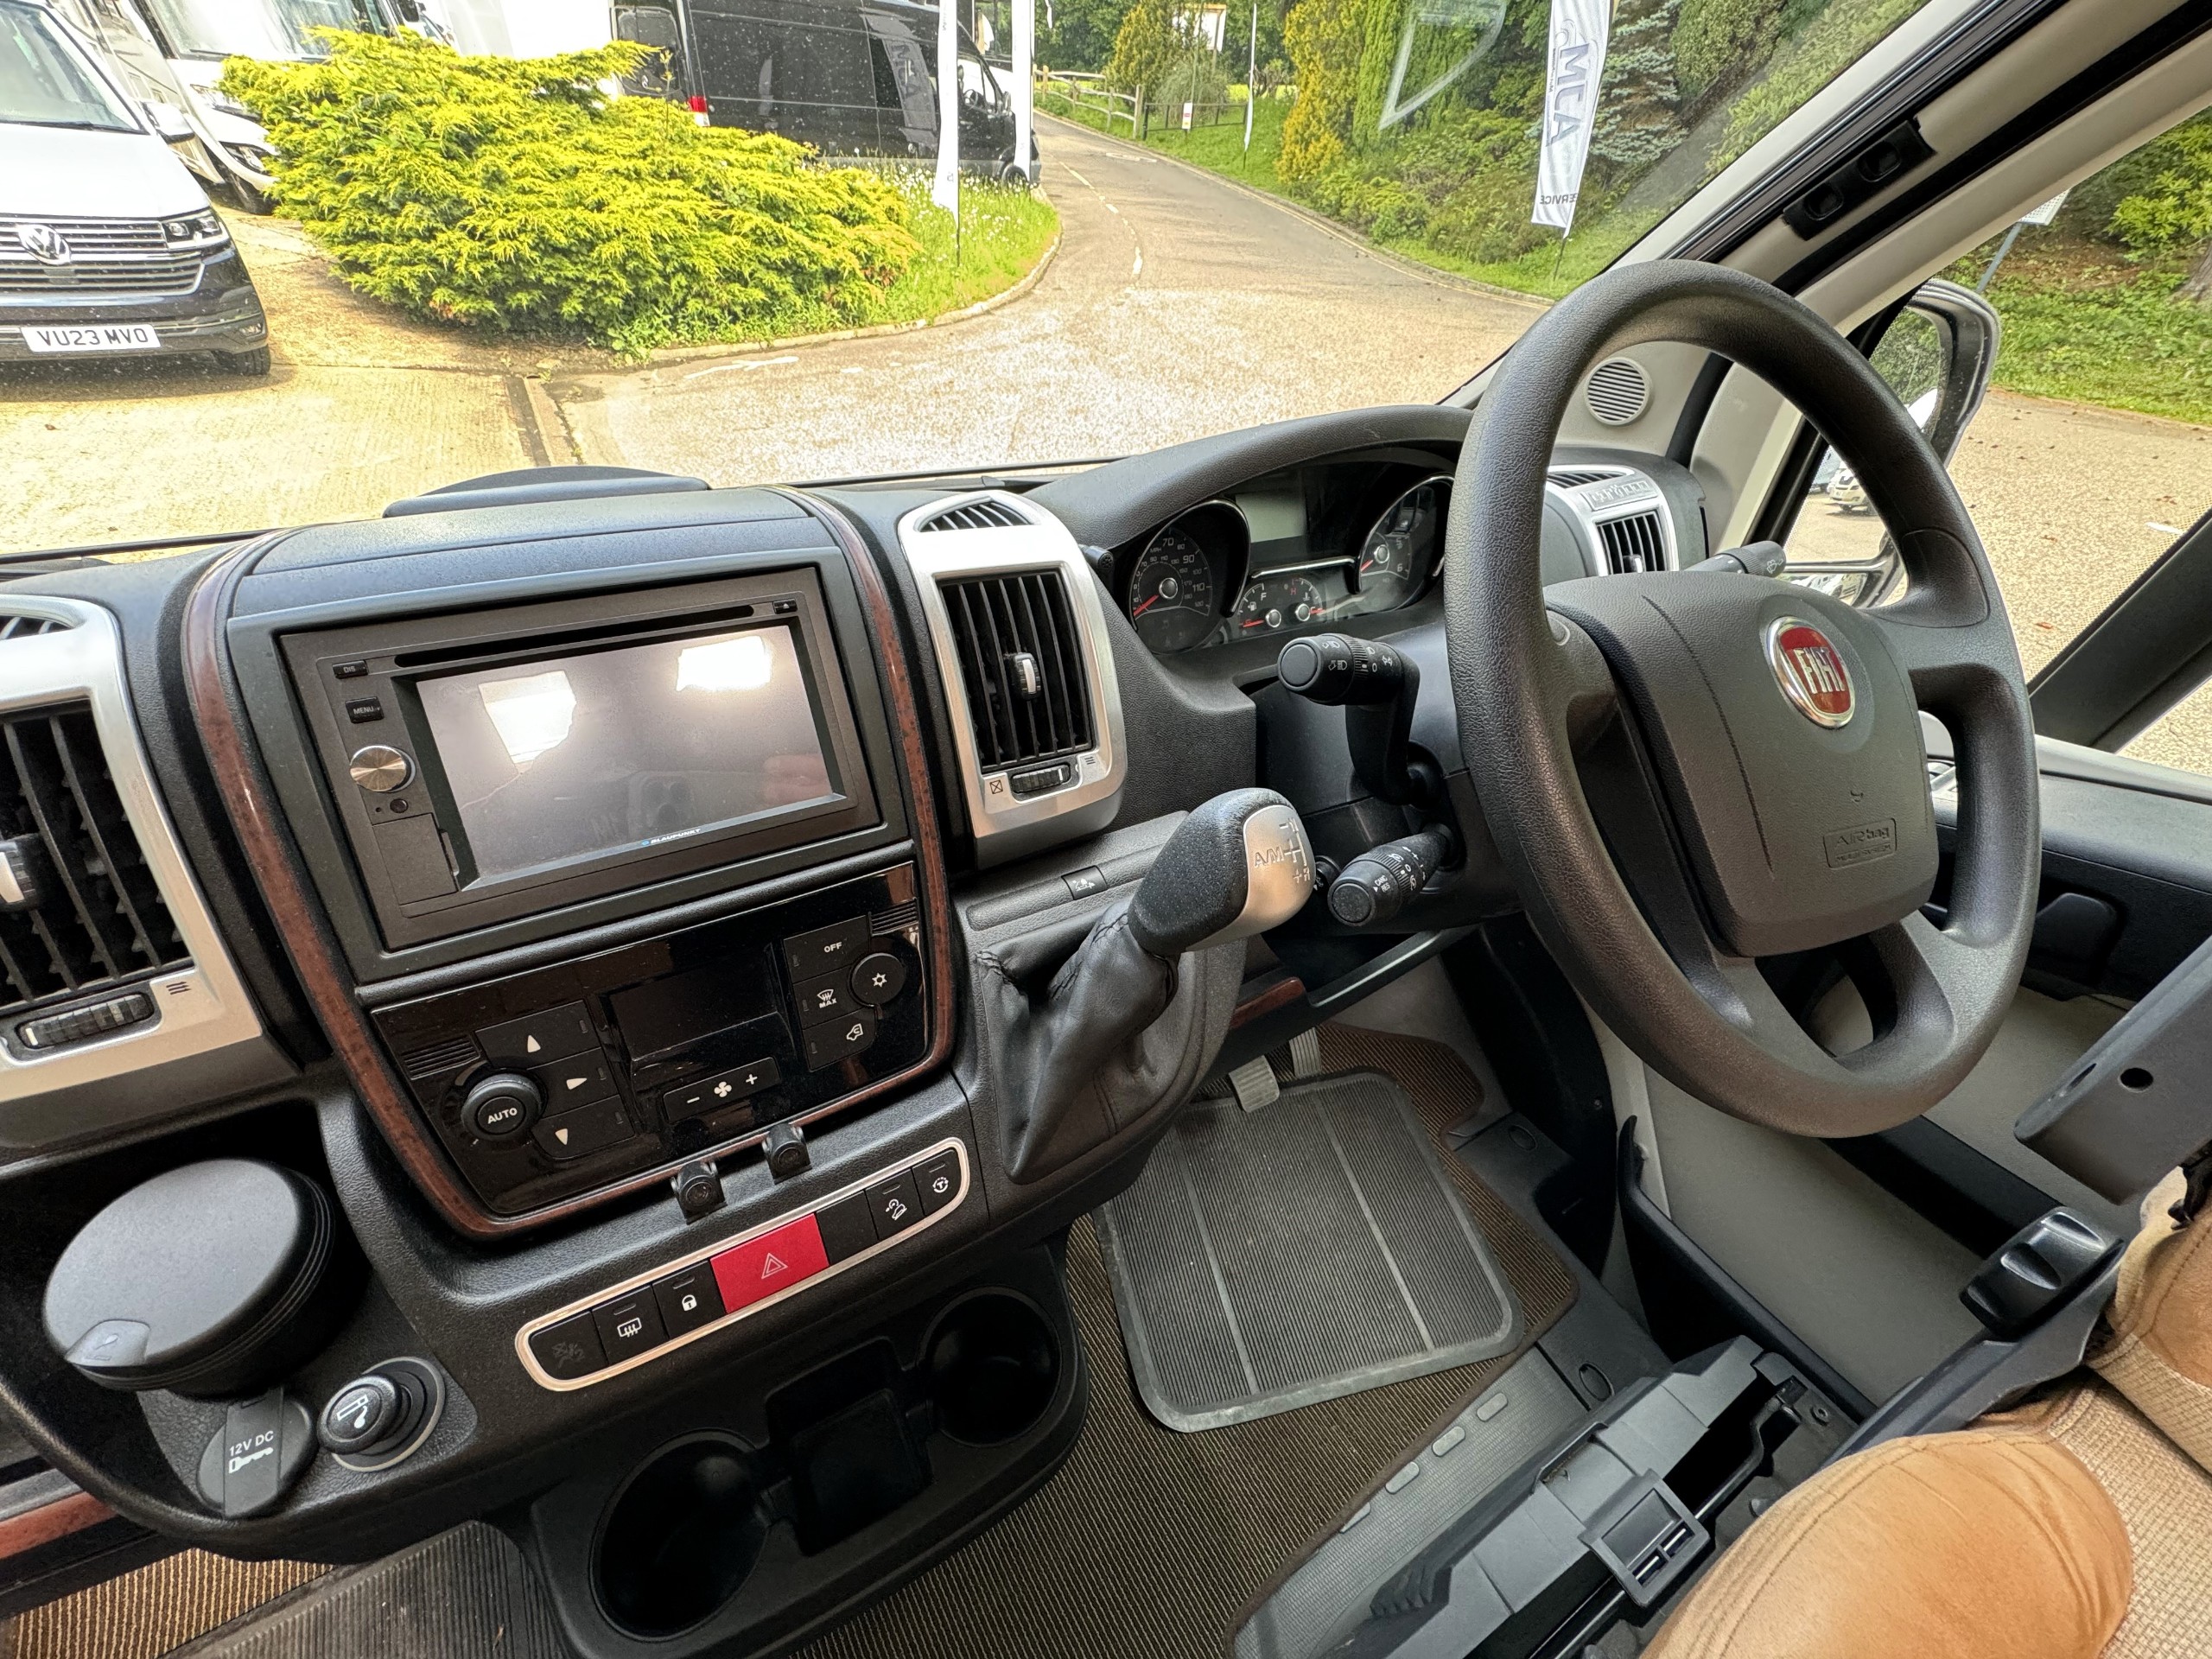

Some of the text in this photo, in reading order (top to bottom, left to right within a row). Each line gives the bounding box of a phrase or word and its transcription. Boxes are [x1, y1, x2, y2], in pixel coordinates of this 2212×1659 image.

[36, 327, 149, 346] VU23 MVO
[1162, 537, 1173, 547] 70
[1183, 554, 1194, 564] 90
[1192, 582, 1205, 592] 110
[1793, 646, 1845, 695] FIAT
[353, 706, 374, 715] MENU
[651, 828, 701, 844] BLAUPUNKT
[823, 941, 843, 953] OFF
[818, 997, 837, 1009] MAX
[487, 1107, 518, 1125] AUTO
[229, 1430, 275, 1457] 12V DC
